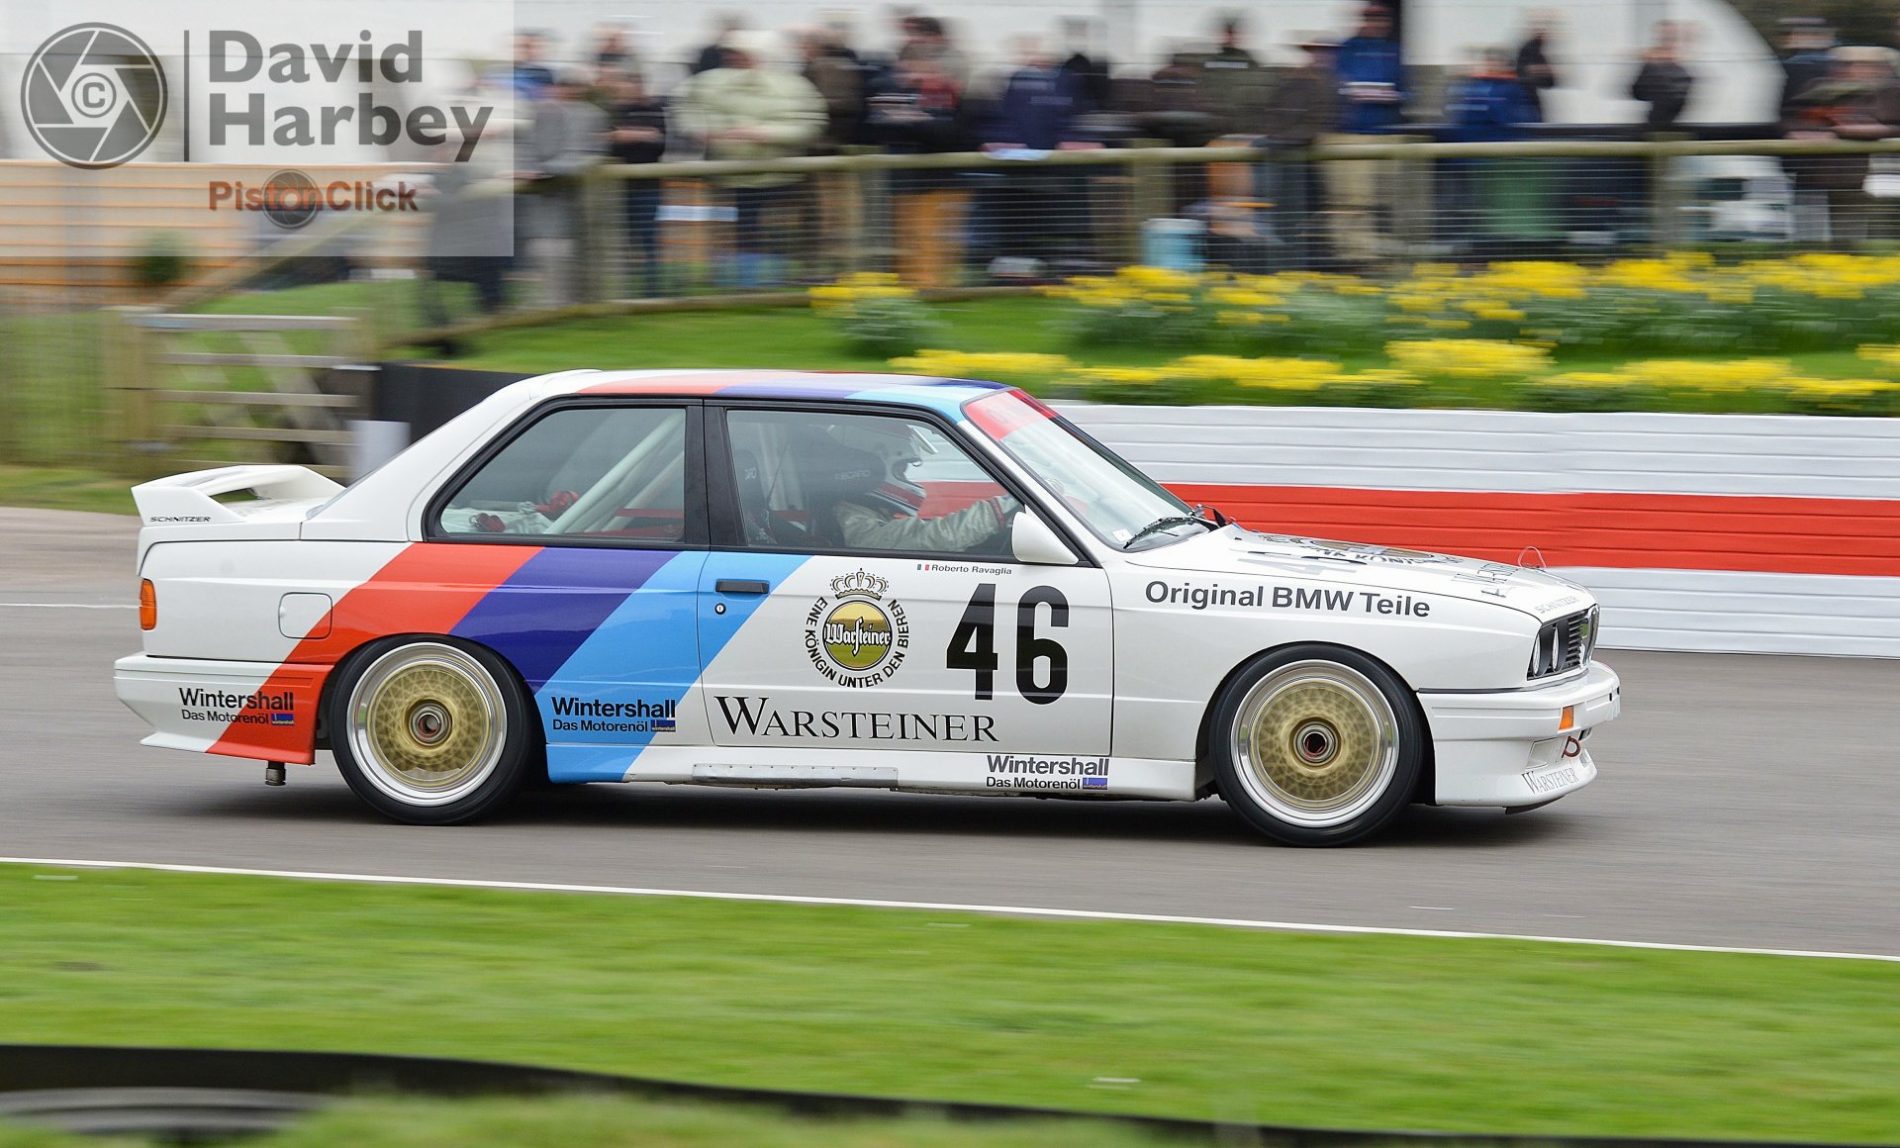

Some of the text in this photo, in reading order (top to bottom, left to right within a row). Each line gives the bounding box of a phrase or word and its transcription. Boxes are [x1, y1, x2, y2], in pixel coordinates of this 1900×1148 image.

[931, 564, 1012, 576] Roberto Ravaglia
[1145, 580, 1431, 618] Original BMW Teile
[805, 597, 910, 689] EINE KÖNIGIN UNTER DEN BIEREN
[946, 583, 1070, 705] 46
[179, 687, 294, 711] Wintershall
[551, 696, 676, 718] Wintershall
[182, 709, 205, 721] Das
[207, 710, 269, 725] Motorenöl
[552, 718, 648, 732] Das Motorenöl
[714, 696, 1000, 742] WARSTEINER
[986, 755, 1110, 776] Wintershall
[986, 776, 1081, 790] Das Motorenöl
